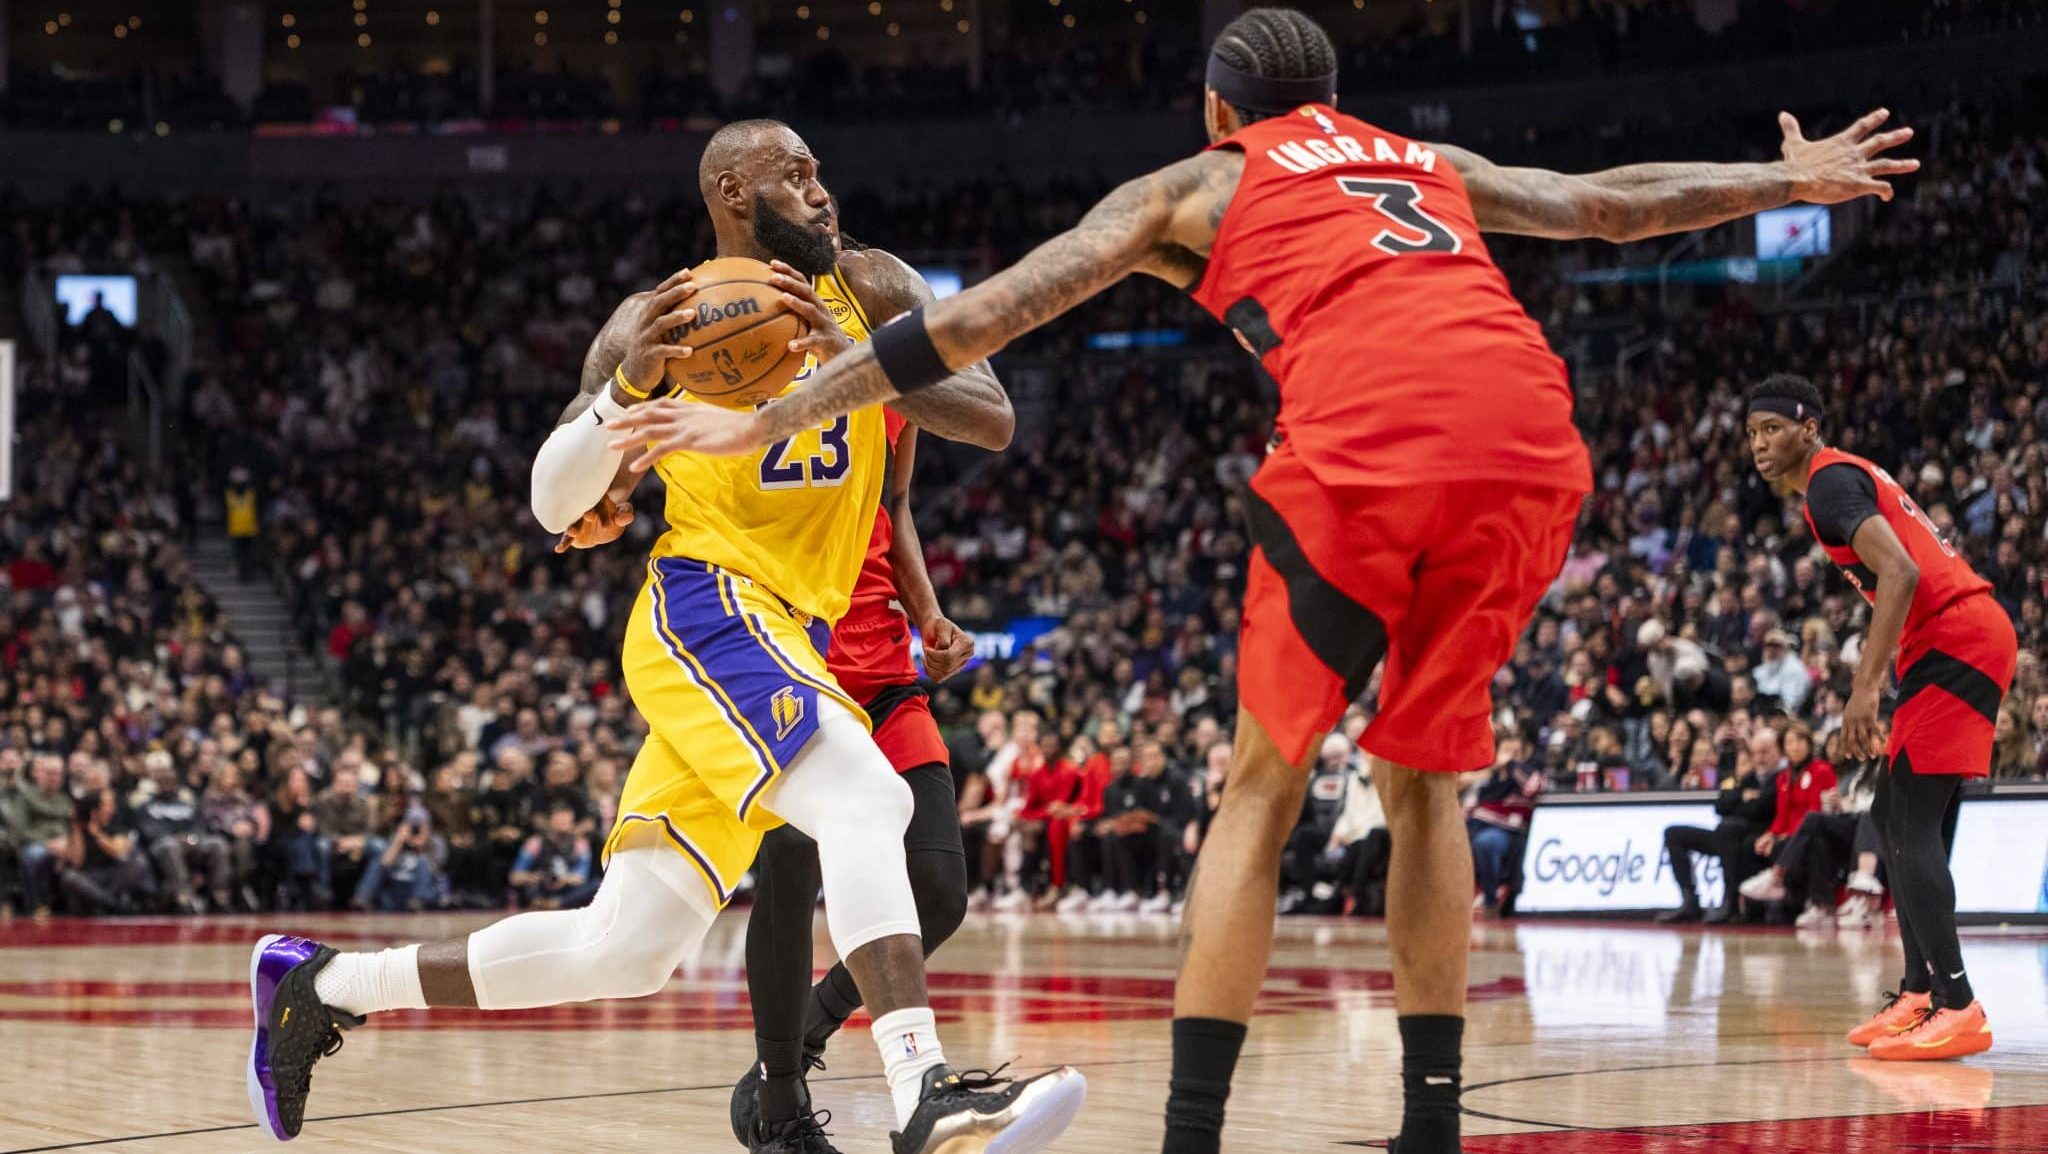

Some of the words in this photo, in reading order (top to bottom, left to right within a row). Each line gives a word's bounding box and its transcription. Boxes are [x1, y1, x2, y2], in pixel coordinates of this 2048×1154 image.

[1266, 135, 1436, 174] INGRAM
[1335, 175, 1462, 256] 3
[754, 397, 855, 491] 23
[1535, 837, 1645, 896] Google
